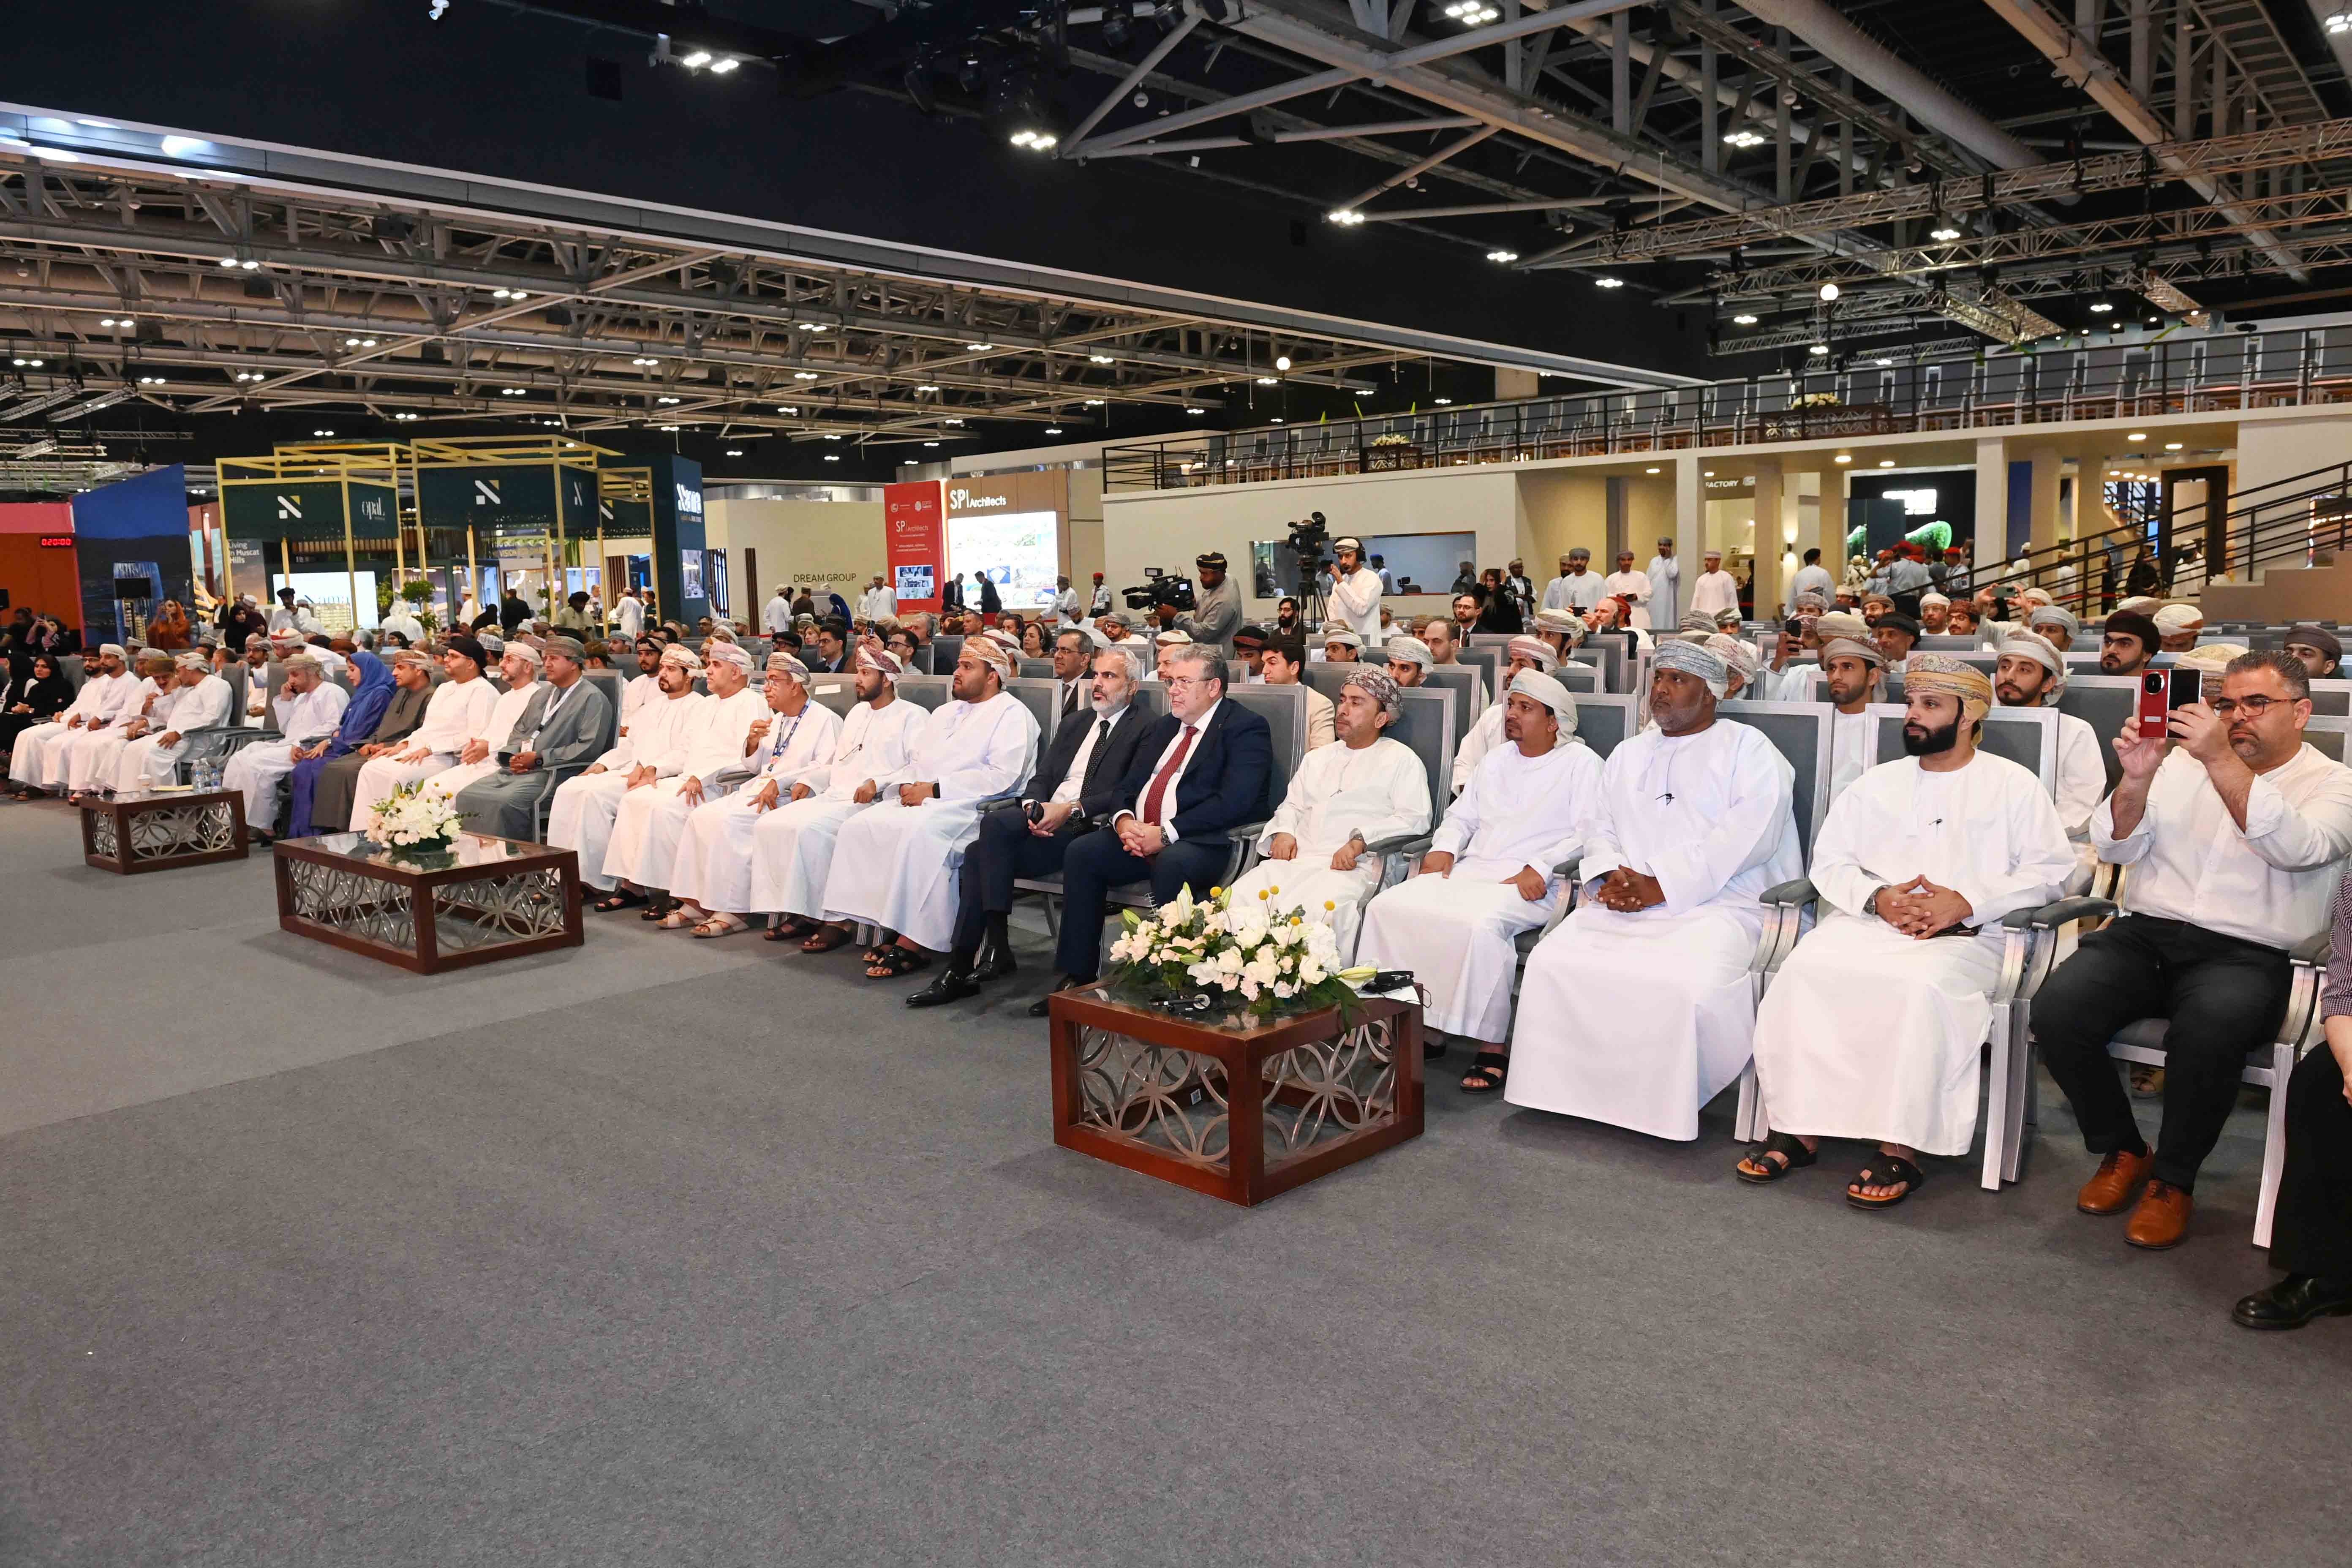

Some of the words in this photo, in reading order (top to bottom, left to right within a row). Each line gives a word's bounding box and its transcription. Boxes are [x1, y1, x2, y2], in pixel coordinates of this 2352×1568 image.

[1706, 480, 1739, 488] FACTORY
[950, 489, 966, 509] SP
[969, 495, 1006, 508] Architects
[896, 520, 905, 532] SP
[794, 574, 824, 582] DREAM
[827, 573, 856, 582] GROUP
